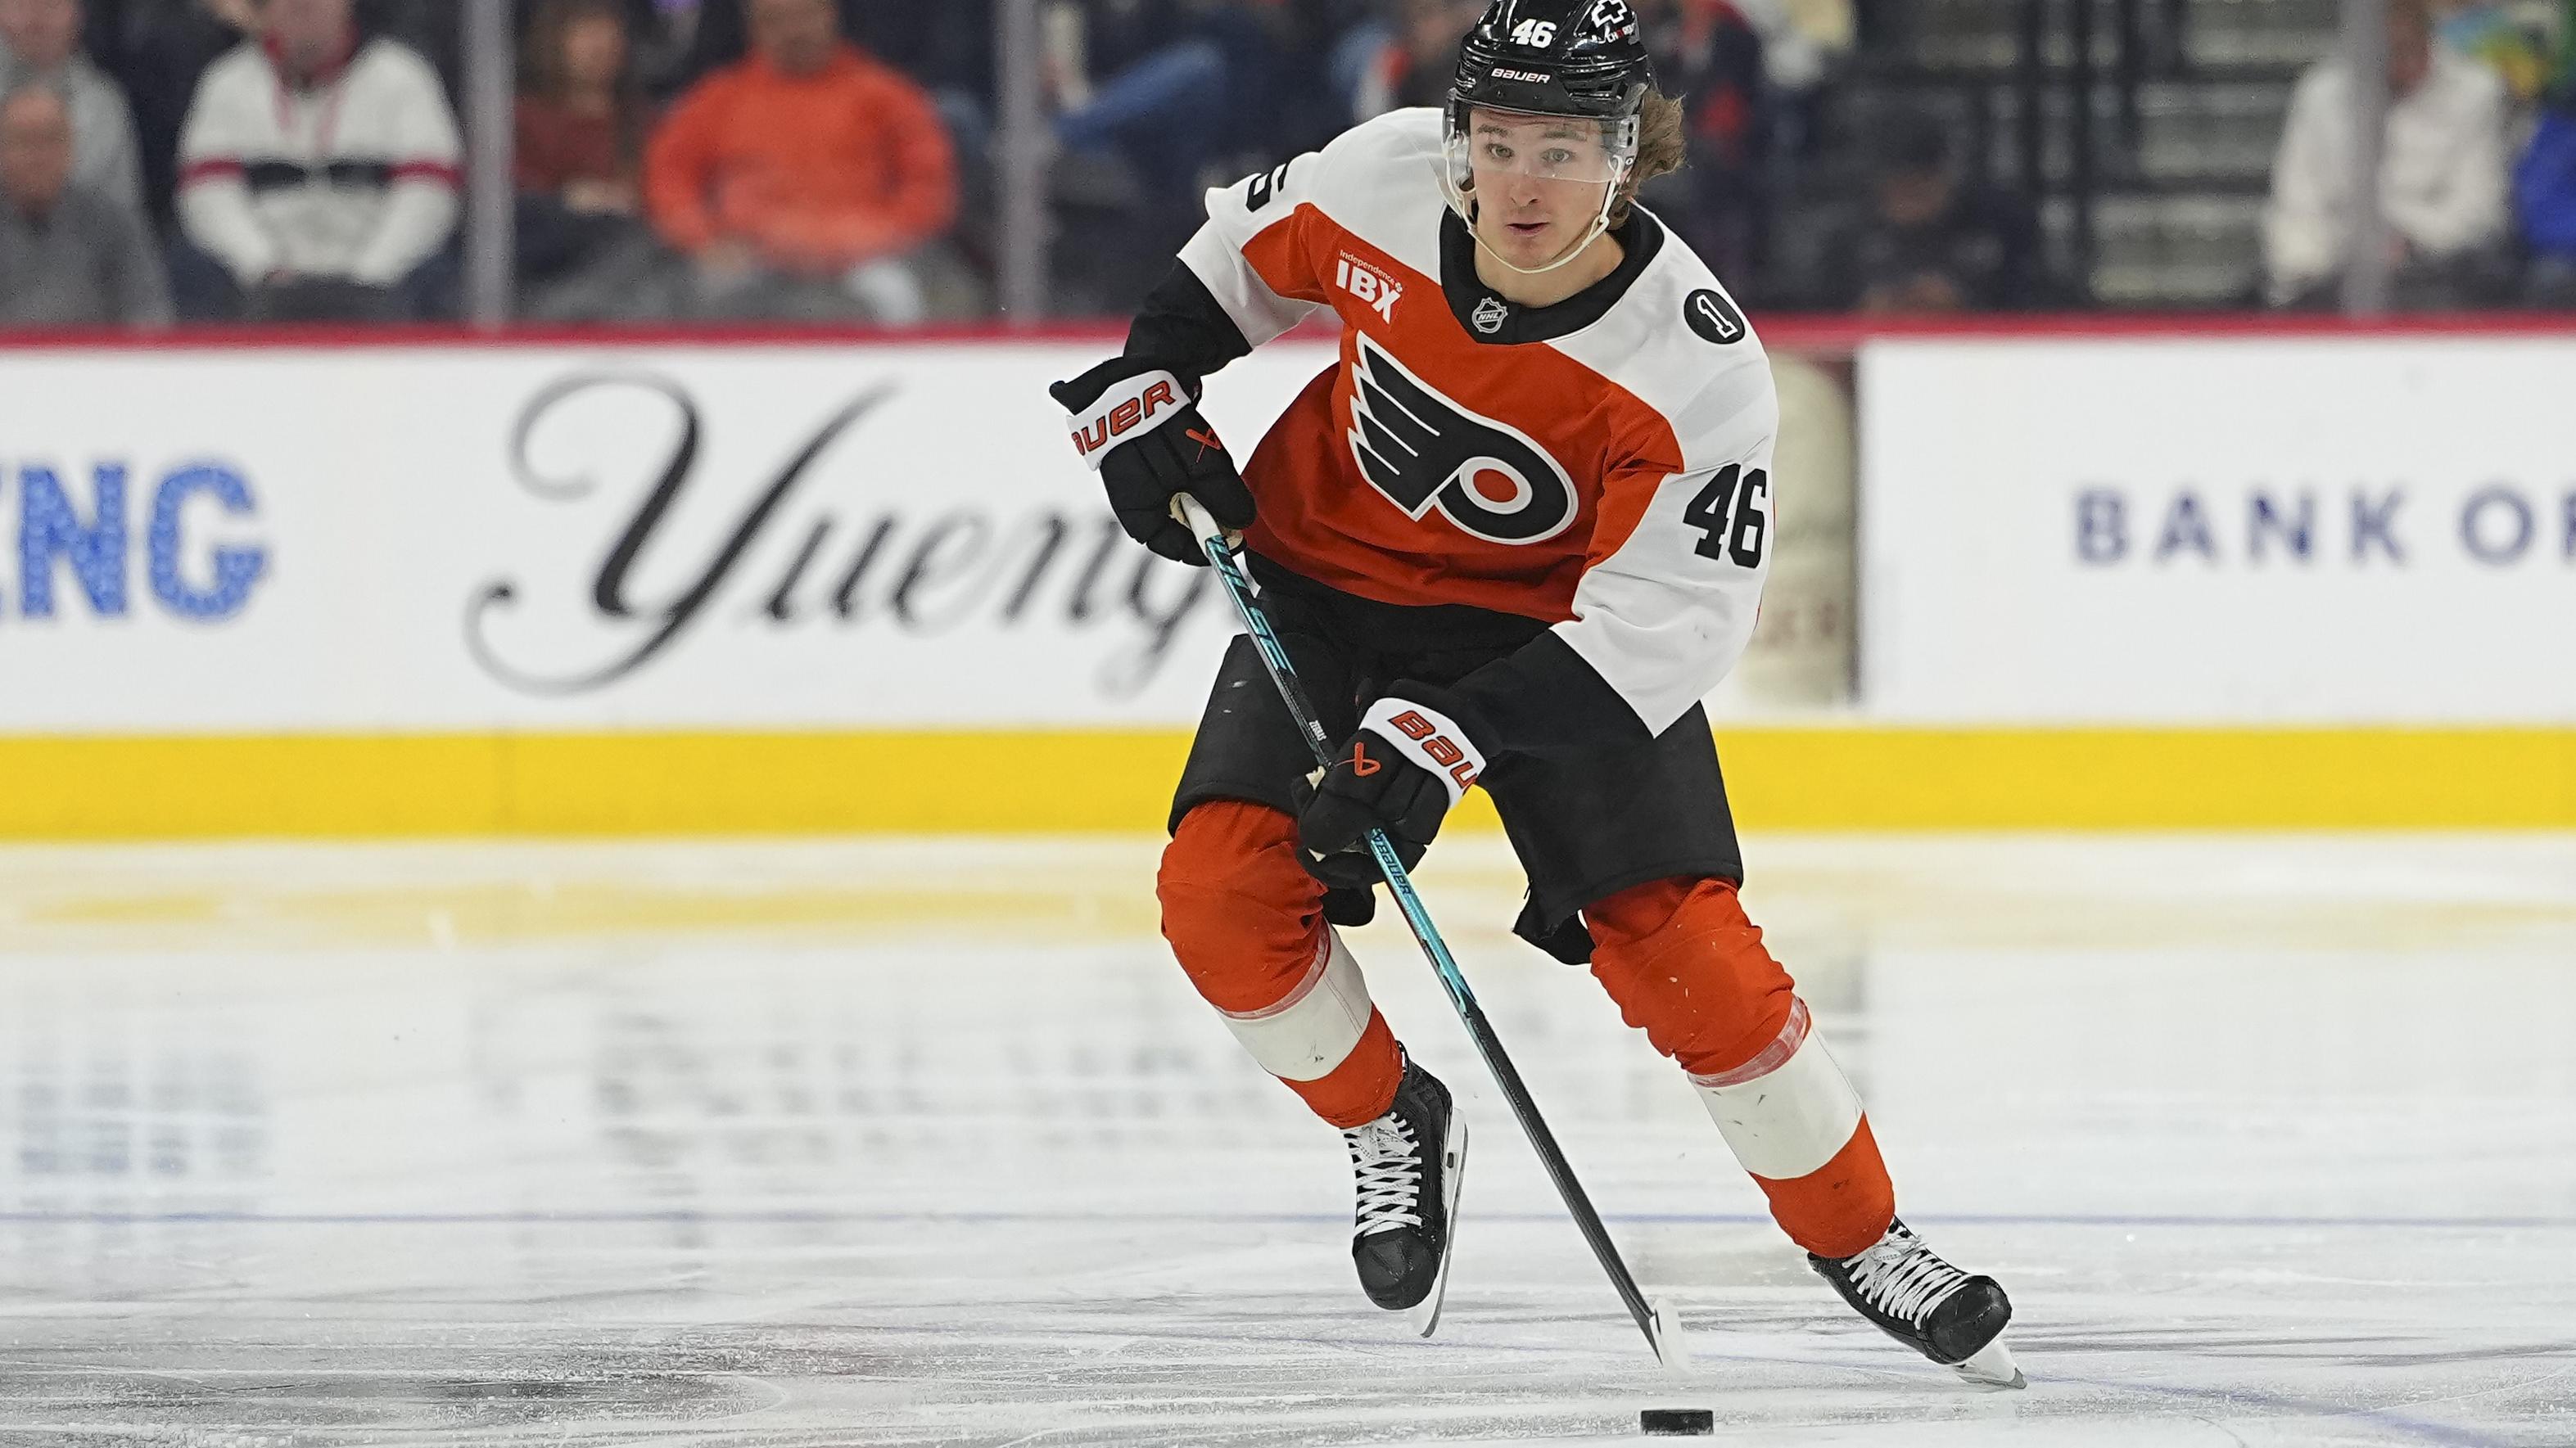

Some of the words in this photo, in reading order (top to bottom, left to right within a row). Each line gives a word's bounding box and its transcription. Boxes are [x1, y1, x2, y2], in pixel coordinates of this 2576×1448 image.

[1491, 68, 1551, 83] BAUER
[1512, 19, 1557, 48] 46
[1335, 259, 1401, 324] IBX
[0, 463, 268, 620] NG
[463, 368, 1220, 699] Yueng
[1683, 462, 1767, 569] 46
[2073, 483, 2405, 565] BANK
[2460, 480, 2576, 566] O
[1387, 710, 1477, 796] BAU
